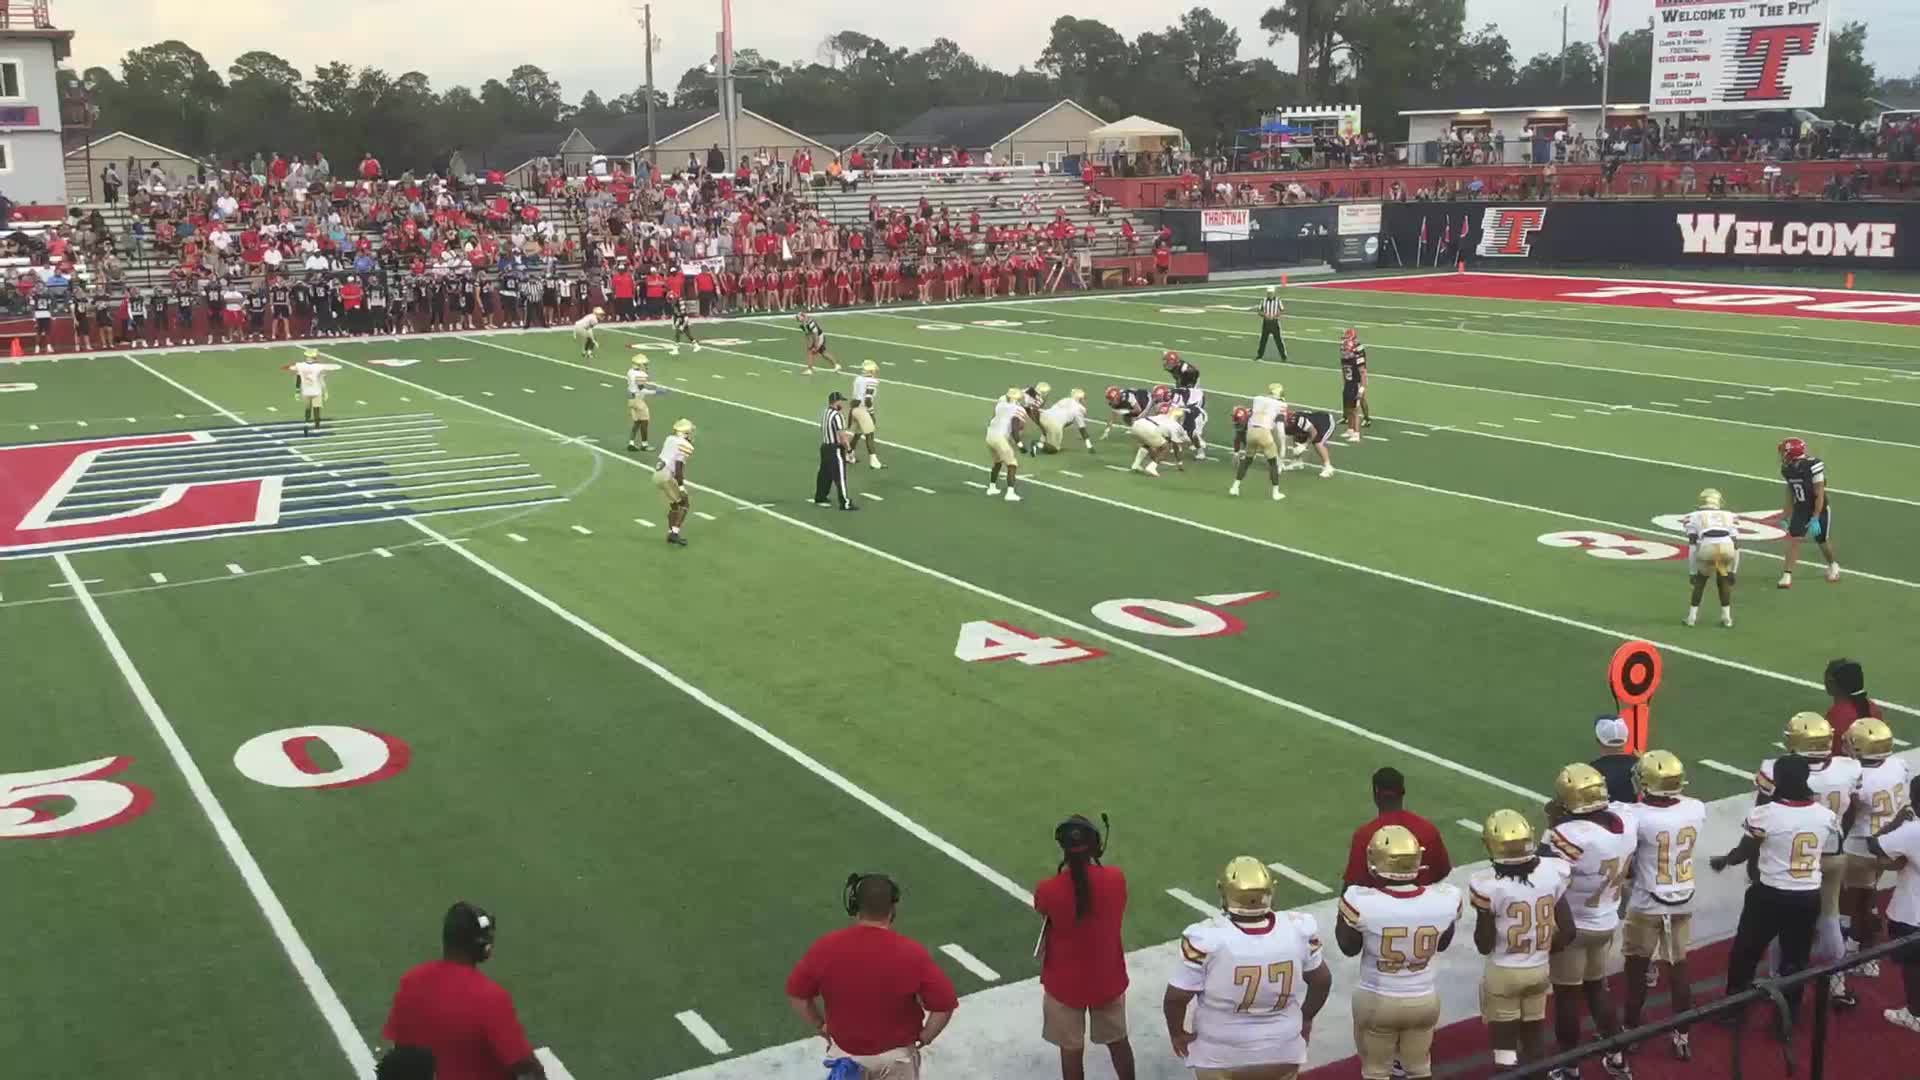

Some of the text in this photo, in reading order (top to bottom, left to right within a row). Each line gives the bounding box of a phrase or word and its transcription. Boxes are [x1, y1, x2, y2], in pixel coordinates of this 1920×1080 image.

[1661, 8, 1726, 23] WELCOME
[1729, 8, 1746, 19] TO
[1204, 211, 1247, 226] THRIFTWAY
[1676, 213, 1897, 258] WELCOME
[1655, 825, 1698, 885] 12
[1788, 832, 1819, 879] 6
[1376, 924, 1440, 975] 59
[1506, 895, 1556, 955] 28
[1233, 960, 1295, 1015] 77
